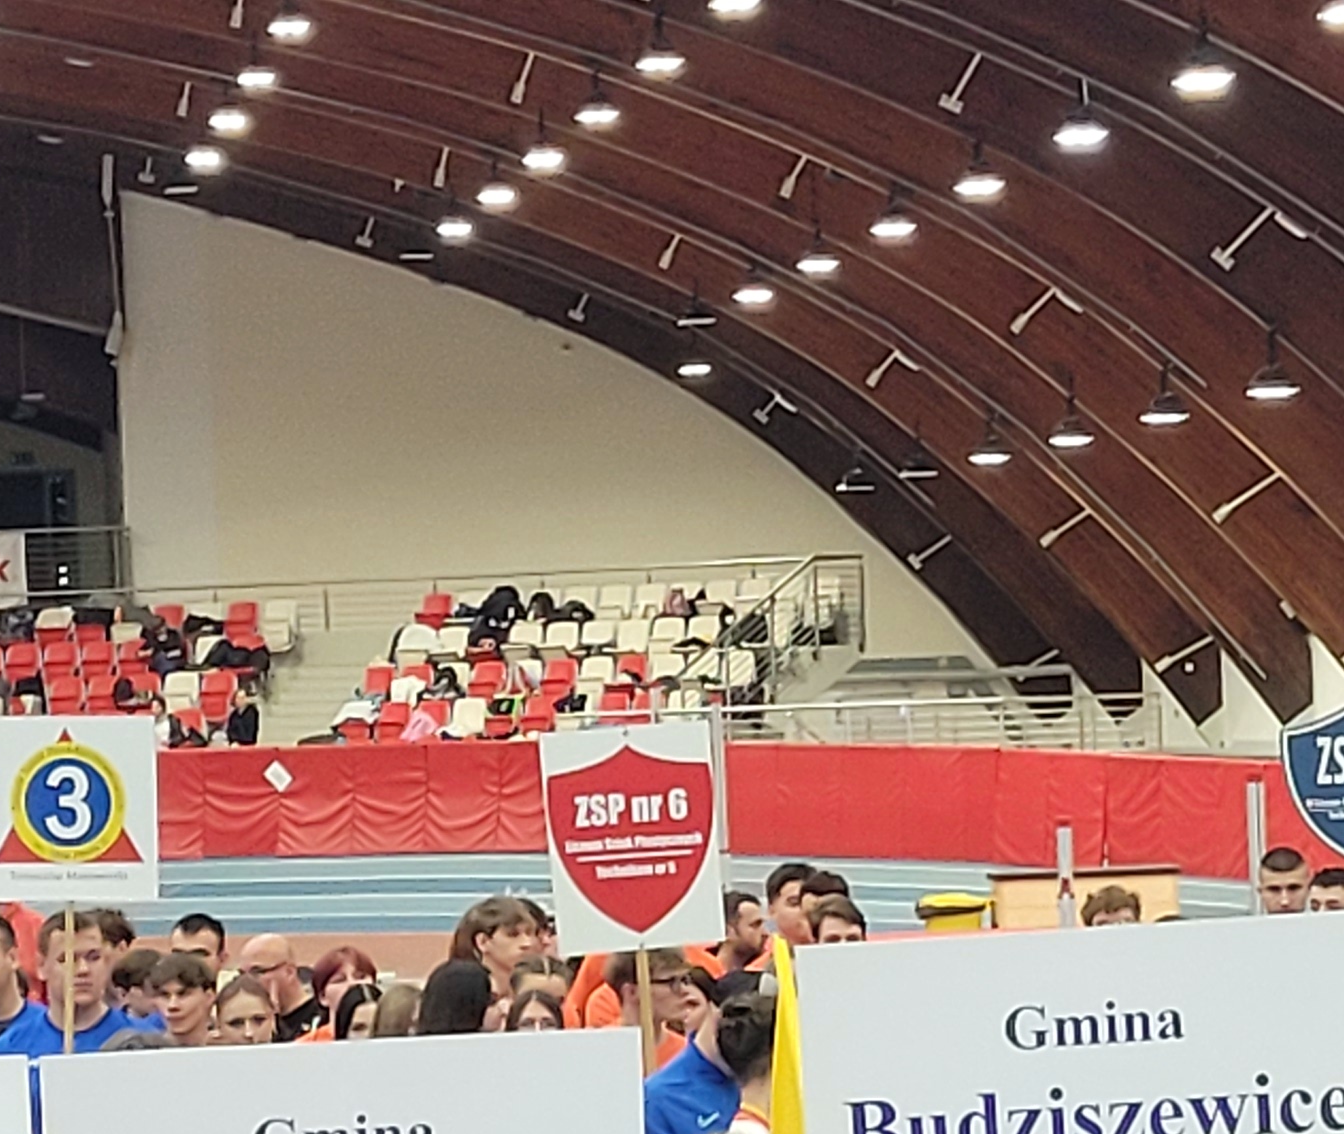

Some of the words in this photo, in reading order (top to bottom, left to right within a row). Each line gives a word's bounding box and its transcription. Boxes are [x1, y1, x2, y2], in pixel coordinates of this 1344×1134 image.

[44, 765, 92, 840] 3
[573, 792, 626, 828] ZSP
[631, 794, 663, 823] nr
[667, 787, 688, 821] 6
[1005, 1000, 1184, 1051] Gmina
